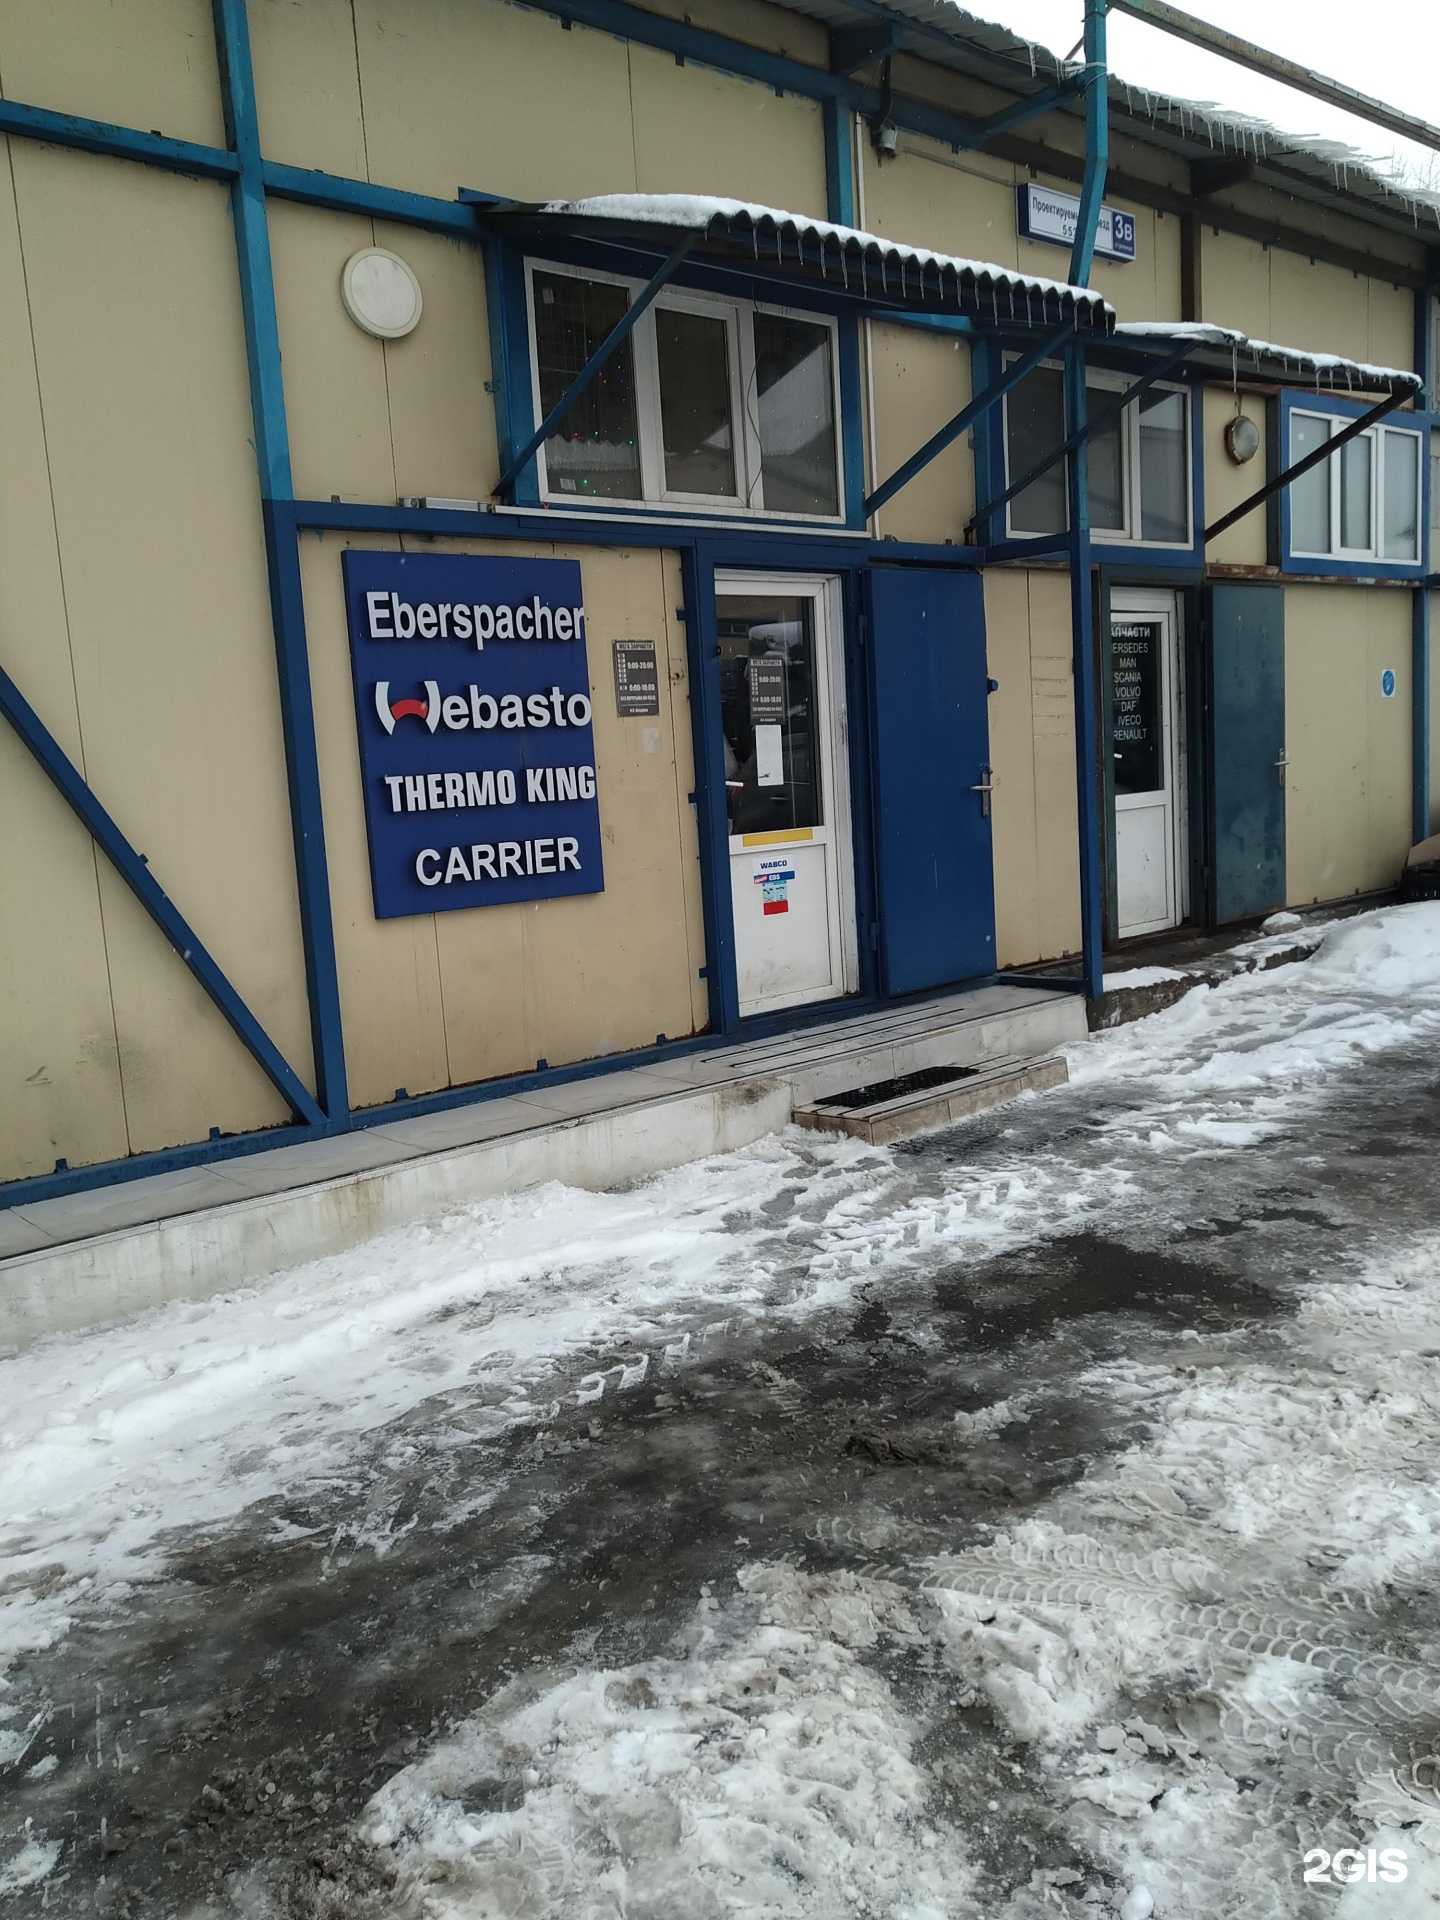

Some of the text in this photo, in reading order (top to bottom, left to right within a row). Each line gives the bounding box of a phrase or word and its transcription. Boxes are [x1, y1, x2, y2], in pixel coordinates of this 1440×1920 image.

[1032, 196, 1079, 221] Проектируем
[366, 591, 585, 651] Eberspacher
[1111, 626, 1150, 638] АПЧАСТИ
[1112, 642, 1149, 653] ERSEDES
[1119, 657, 1137, 669] MAN
[1113, 671, 1142, 684] SCANIA
[1115, 686, 1141, 698] VOLVO
[375, 680, 592, 736] Webasto
[1121, 701, 1137, 713] DAF
[1118, 715, 1142, 727] IVECO
[1113, 728, 1147, 741] RENAULT
[385, 765, 596, 813] THERMO KING
[415, 836, 582, 887] CARRIER
[760, 859, 788, 870] WABCO
